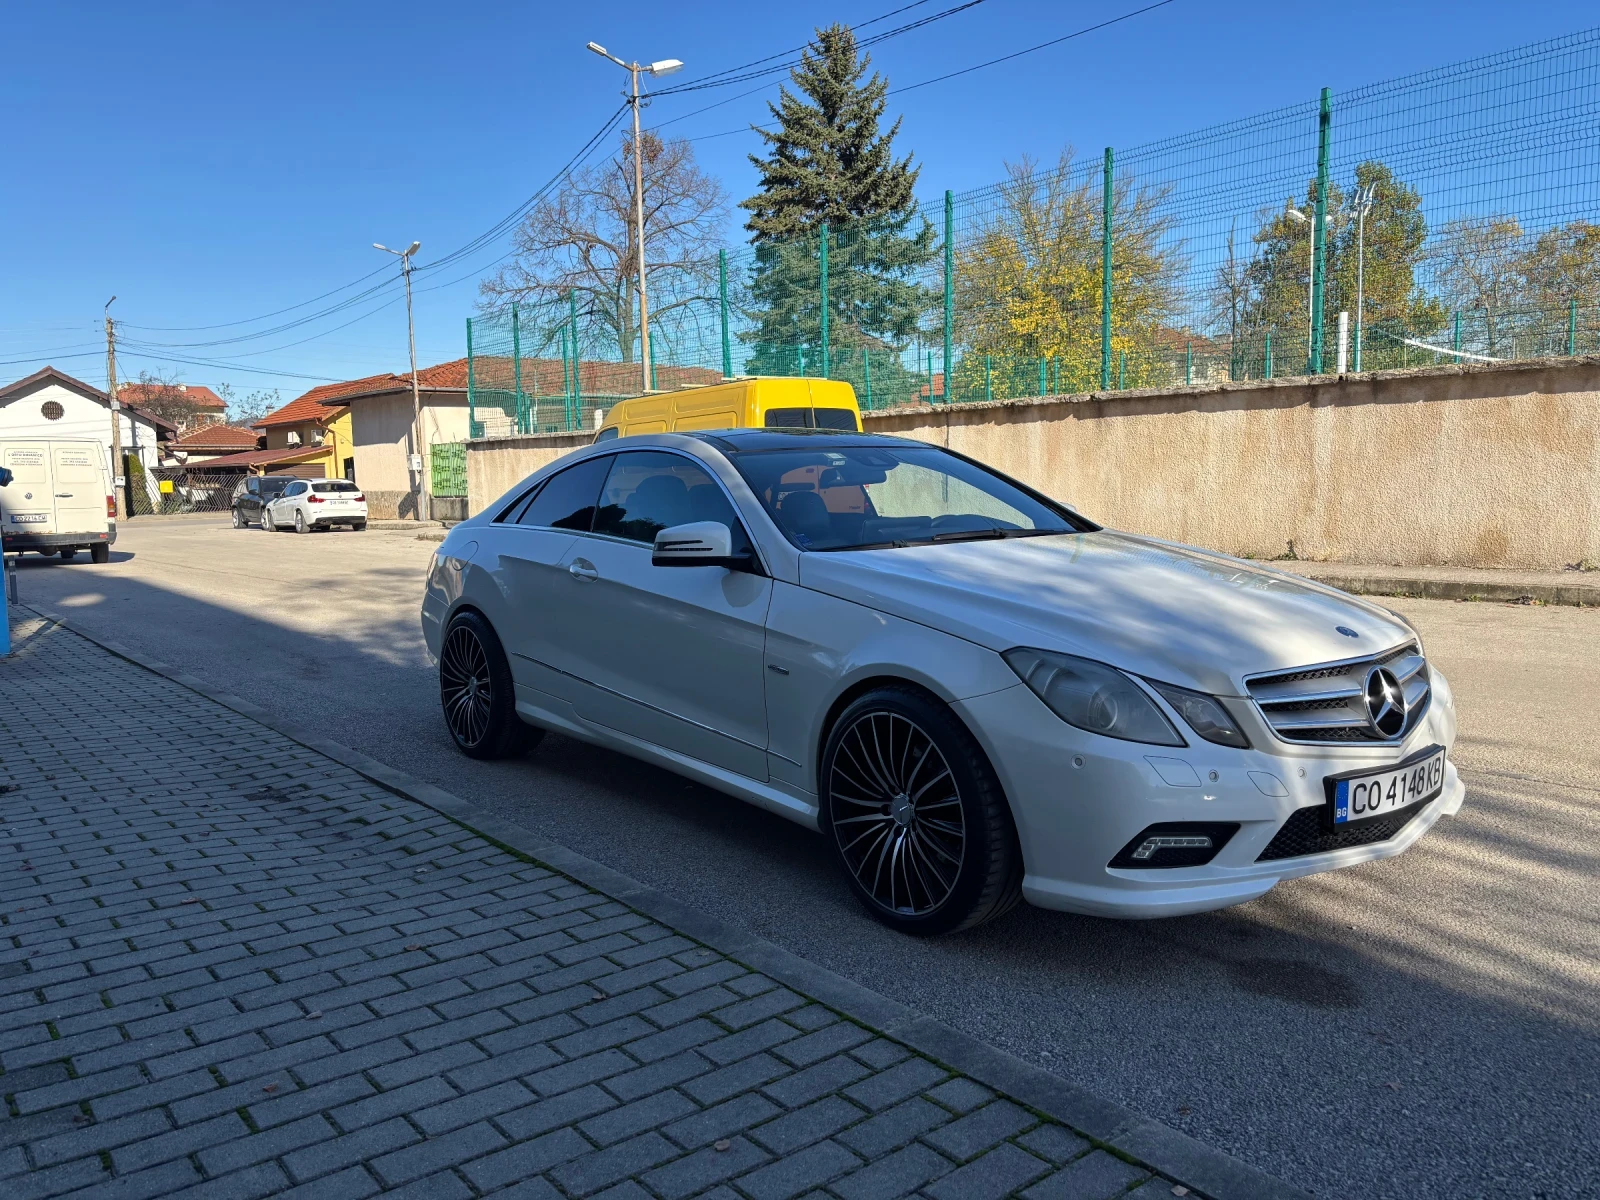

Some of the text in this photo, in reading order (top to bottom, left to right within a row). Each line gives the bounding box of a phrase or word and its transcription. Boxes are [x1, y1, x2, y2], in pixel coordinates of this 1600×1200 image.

[1352, 757, 1441, 814] CO 4148 KB
[1337, 807, 1347, 818] BG
